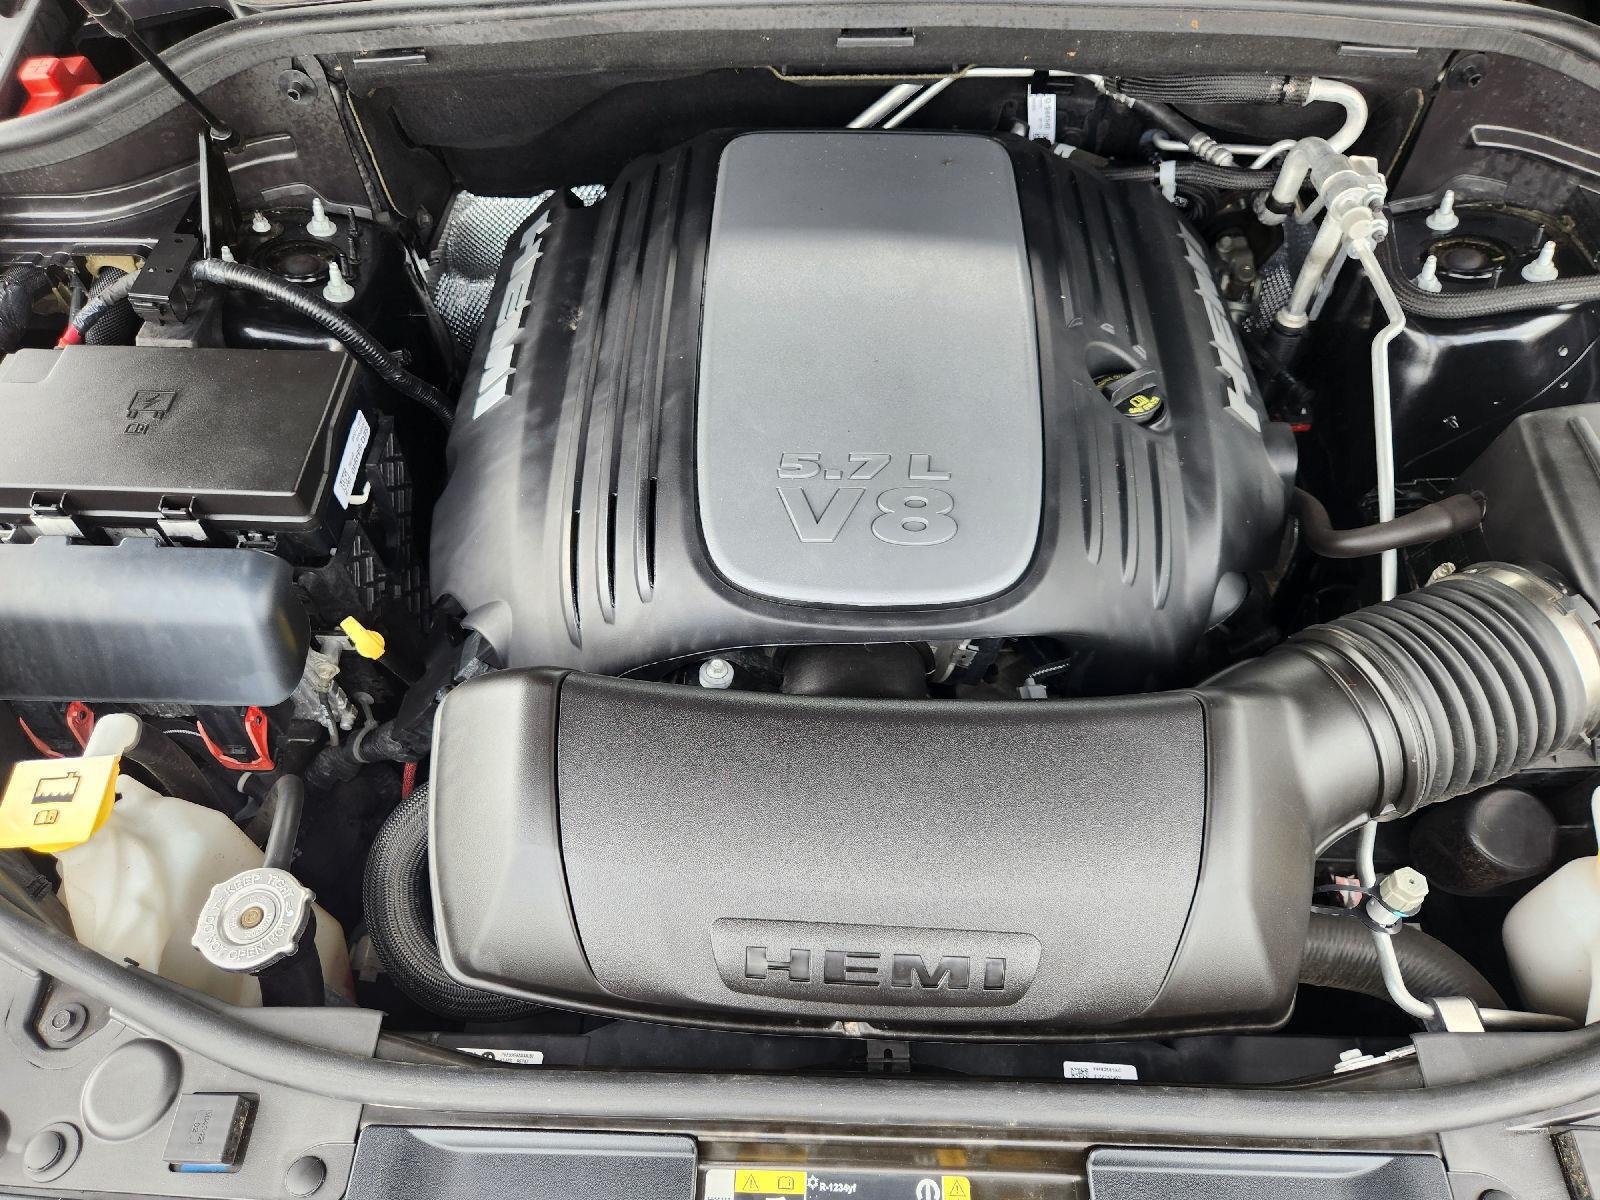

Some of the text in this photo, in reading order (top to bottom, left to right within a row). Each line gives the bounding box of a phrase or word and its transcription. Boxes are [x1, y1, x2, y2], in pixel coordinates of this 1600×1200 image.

[472, 209, 552, 420] HEMI
[1176, 219, 1262, 432] HEMI
[776, 451, 952, 481] 5.7 L
[775, 486, 959, 546] V8
[744, 945, 1007, 991] HEMI
[819, 1181, 858, 1195] R-1234yf
